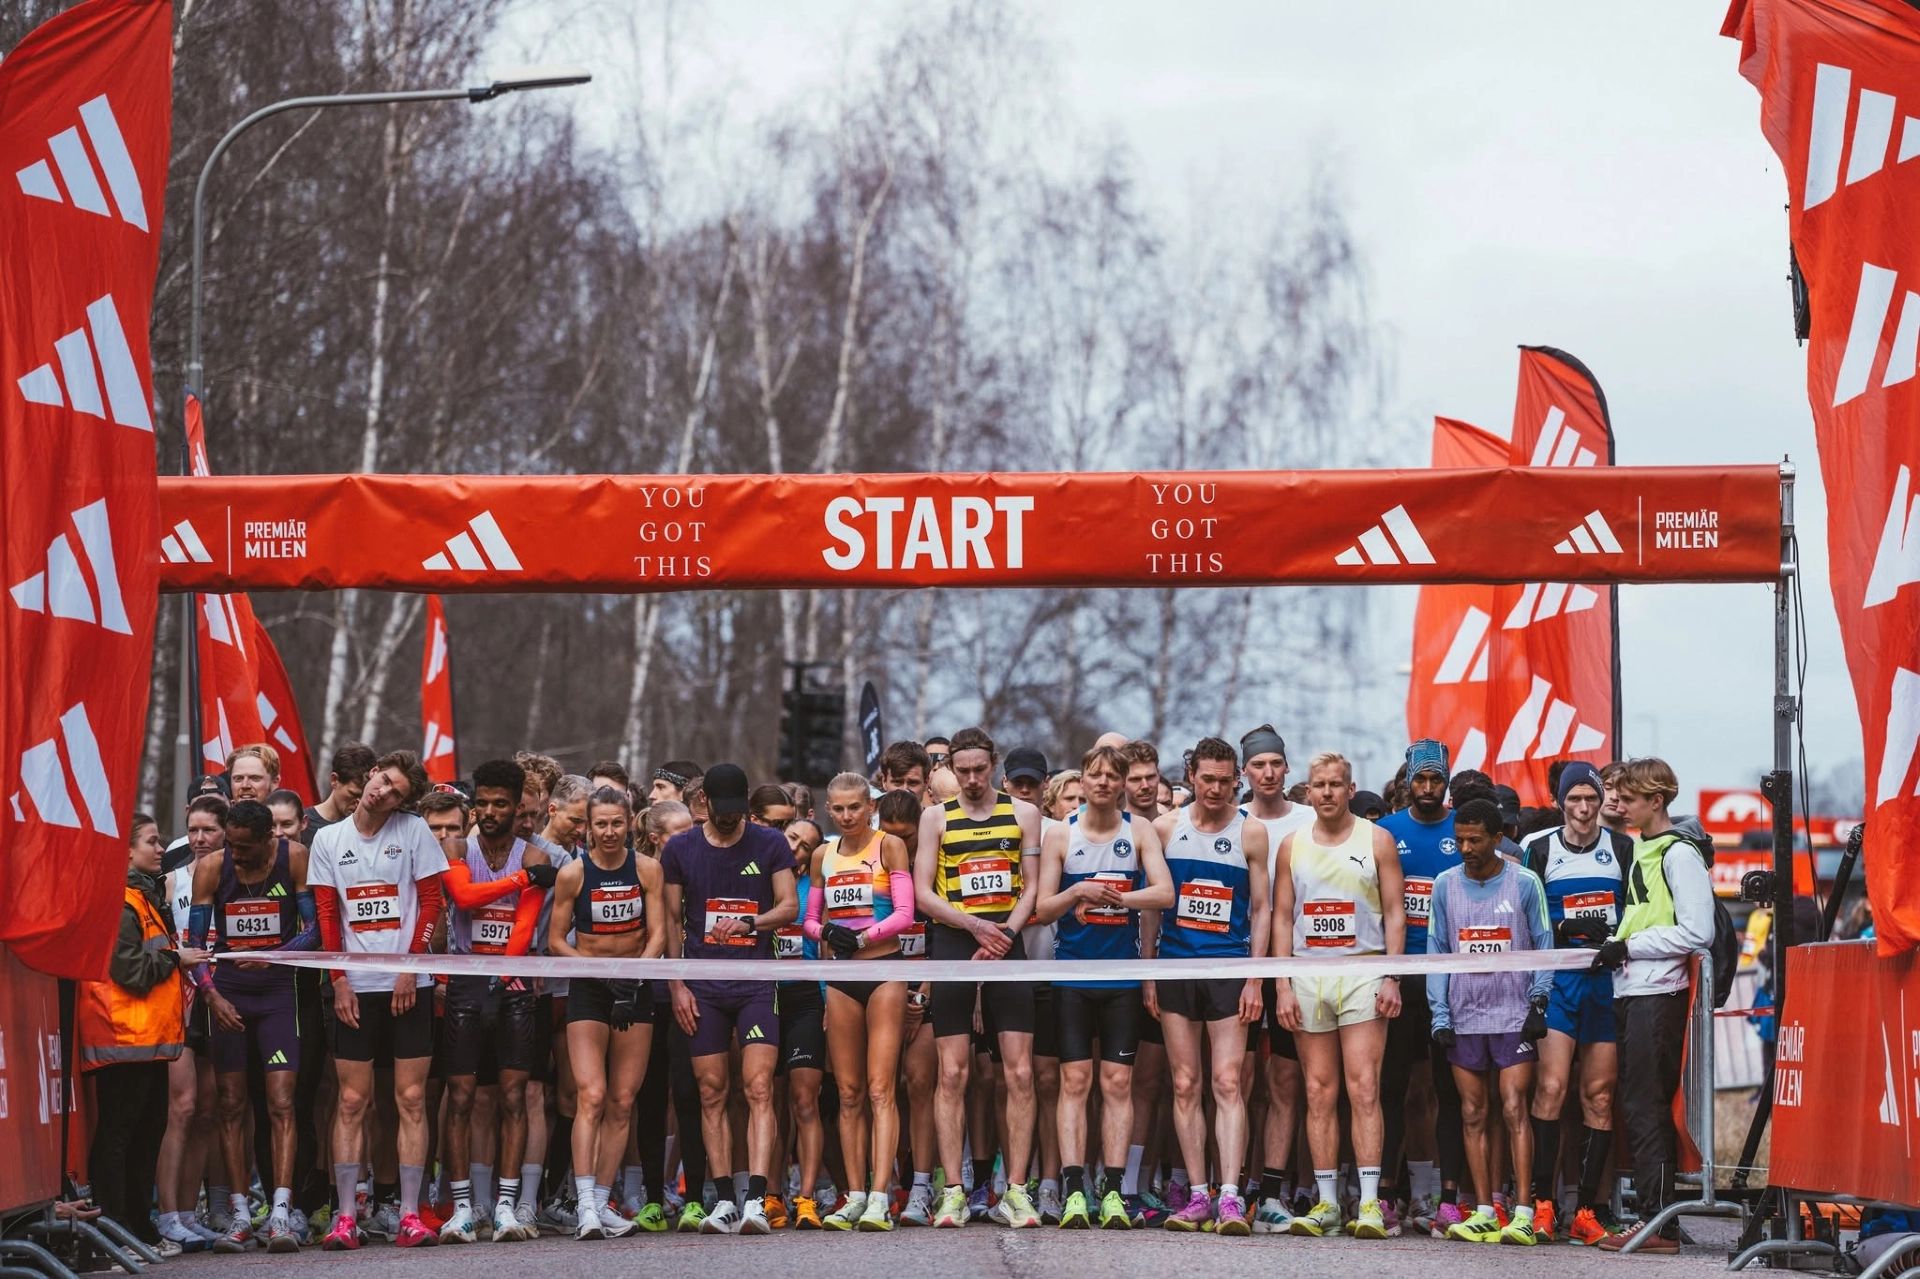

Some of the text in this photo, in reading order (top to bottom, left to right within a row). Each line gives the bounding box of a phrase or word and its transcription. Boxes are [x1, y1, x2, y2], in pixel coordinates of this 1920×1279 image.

[640, 486, 705, 508] YOU
[1151, 484, 1216, 504] YOU
[1151, 518, 1217, 539] GOT
[1656, 509, 1718, 529] PREMIÄR
[245, 519, 306, 539] PREMIÄR
[639, 522, 706, 542] GOT
[822, 496, 1034, 570] START
[245, 540, 306, 558] MILEN
[1656, 531, 1718, 549] MILEN
[634, 556, 711, 577] THIS
[1146, 553, 1223, 573] THIS
[971, 874, 1003, 891] 6173
[833, 887, 863, 904] 6484
[357, 900, 390, 917] 5973
[602, 902, 635, 919] 6174
[1188, 900, 1221, 917] 5912
[236, 917, 271, 933] 6431
[421, 922, 434, 943] VOID
[480, 923, 512, 940] 5971
[1313, 917, 1346, 933] 5908
[779, 938, 794, 953] 04
[900, 938, 916, 952] 77
[1776, 1020, 1805, 1063] REMIÄR
[1773, 1068, 1803, 1107] ILEN
